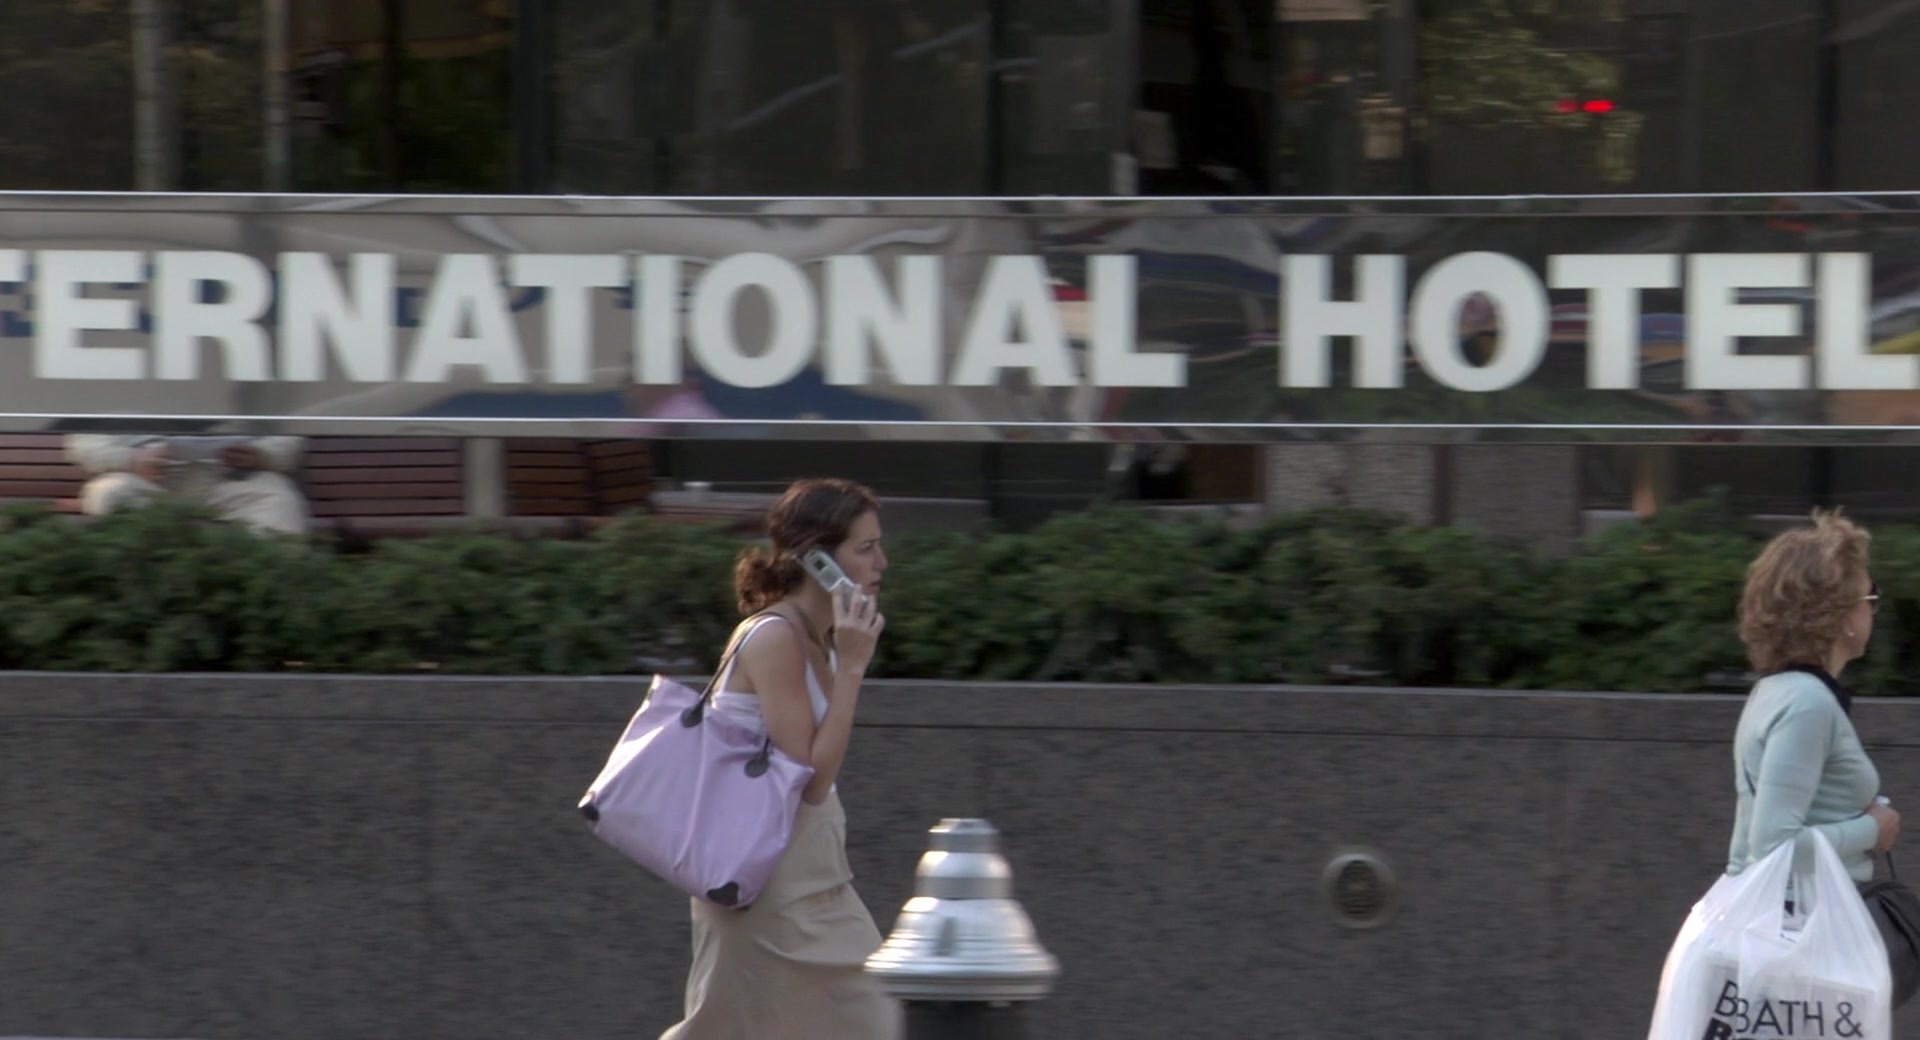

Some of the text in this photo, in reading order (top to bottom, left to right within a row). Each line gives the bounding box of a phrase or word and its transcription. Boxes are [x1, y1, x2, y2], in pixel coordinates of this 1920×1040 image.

[0, 248, 1919, 392] ERNATIONAL HOTEL
[1834, 1001, 1865, 1038] &
